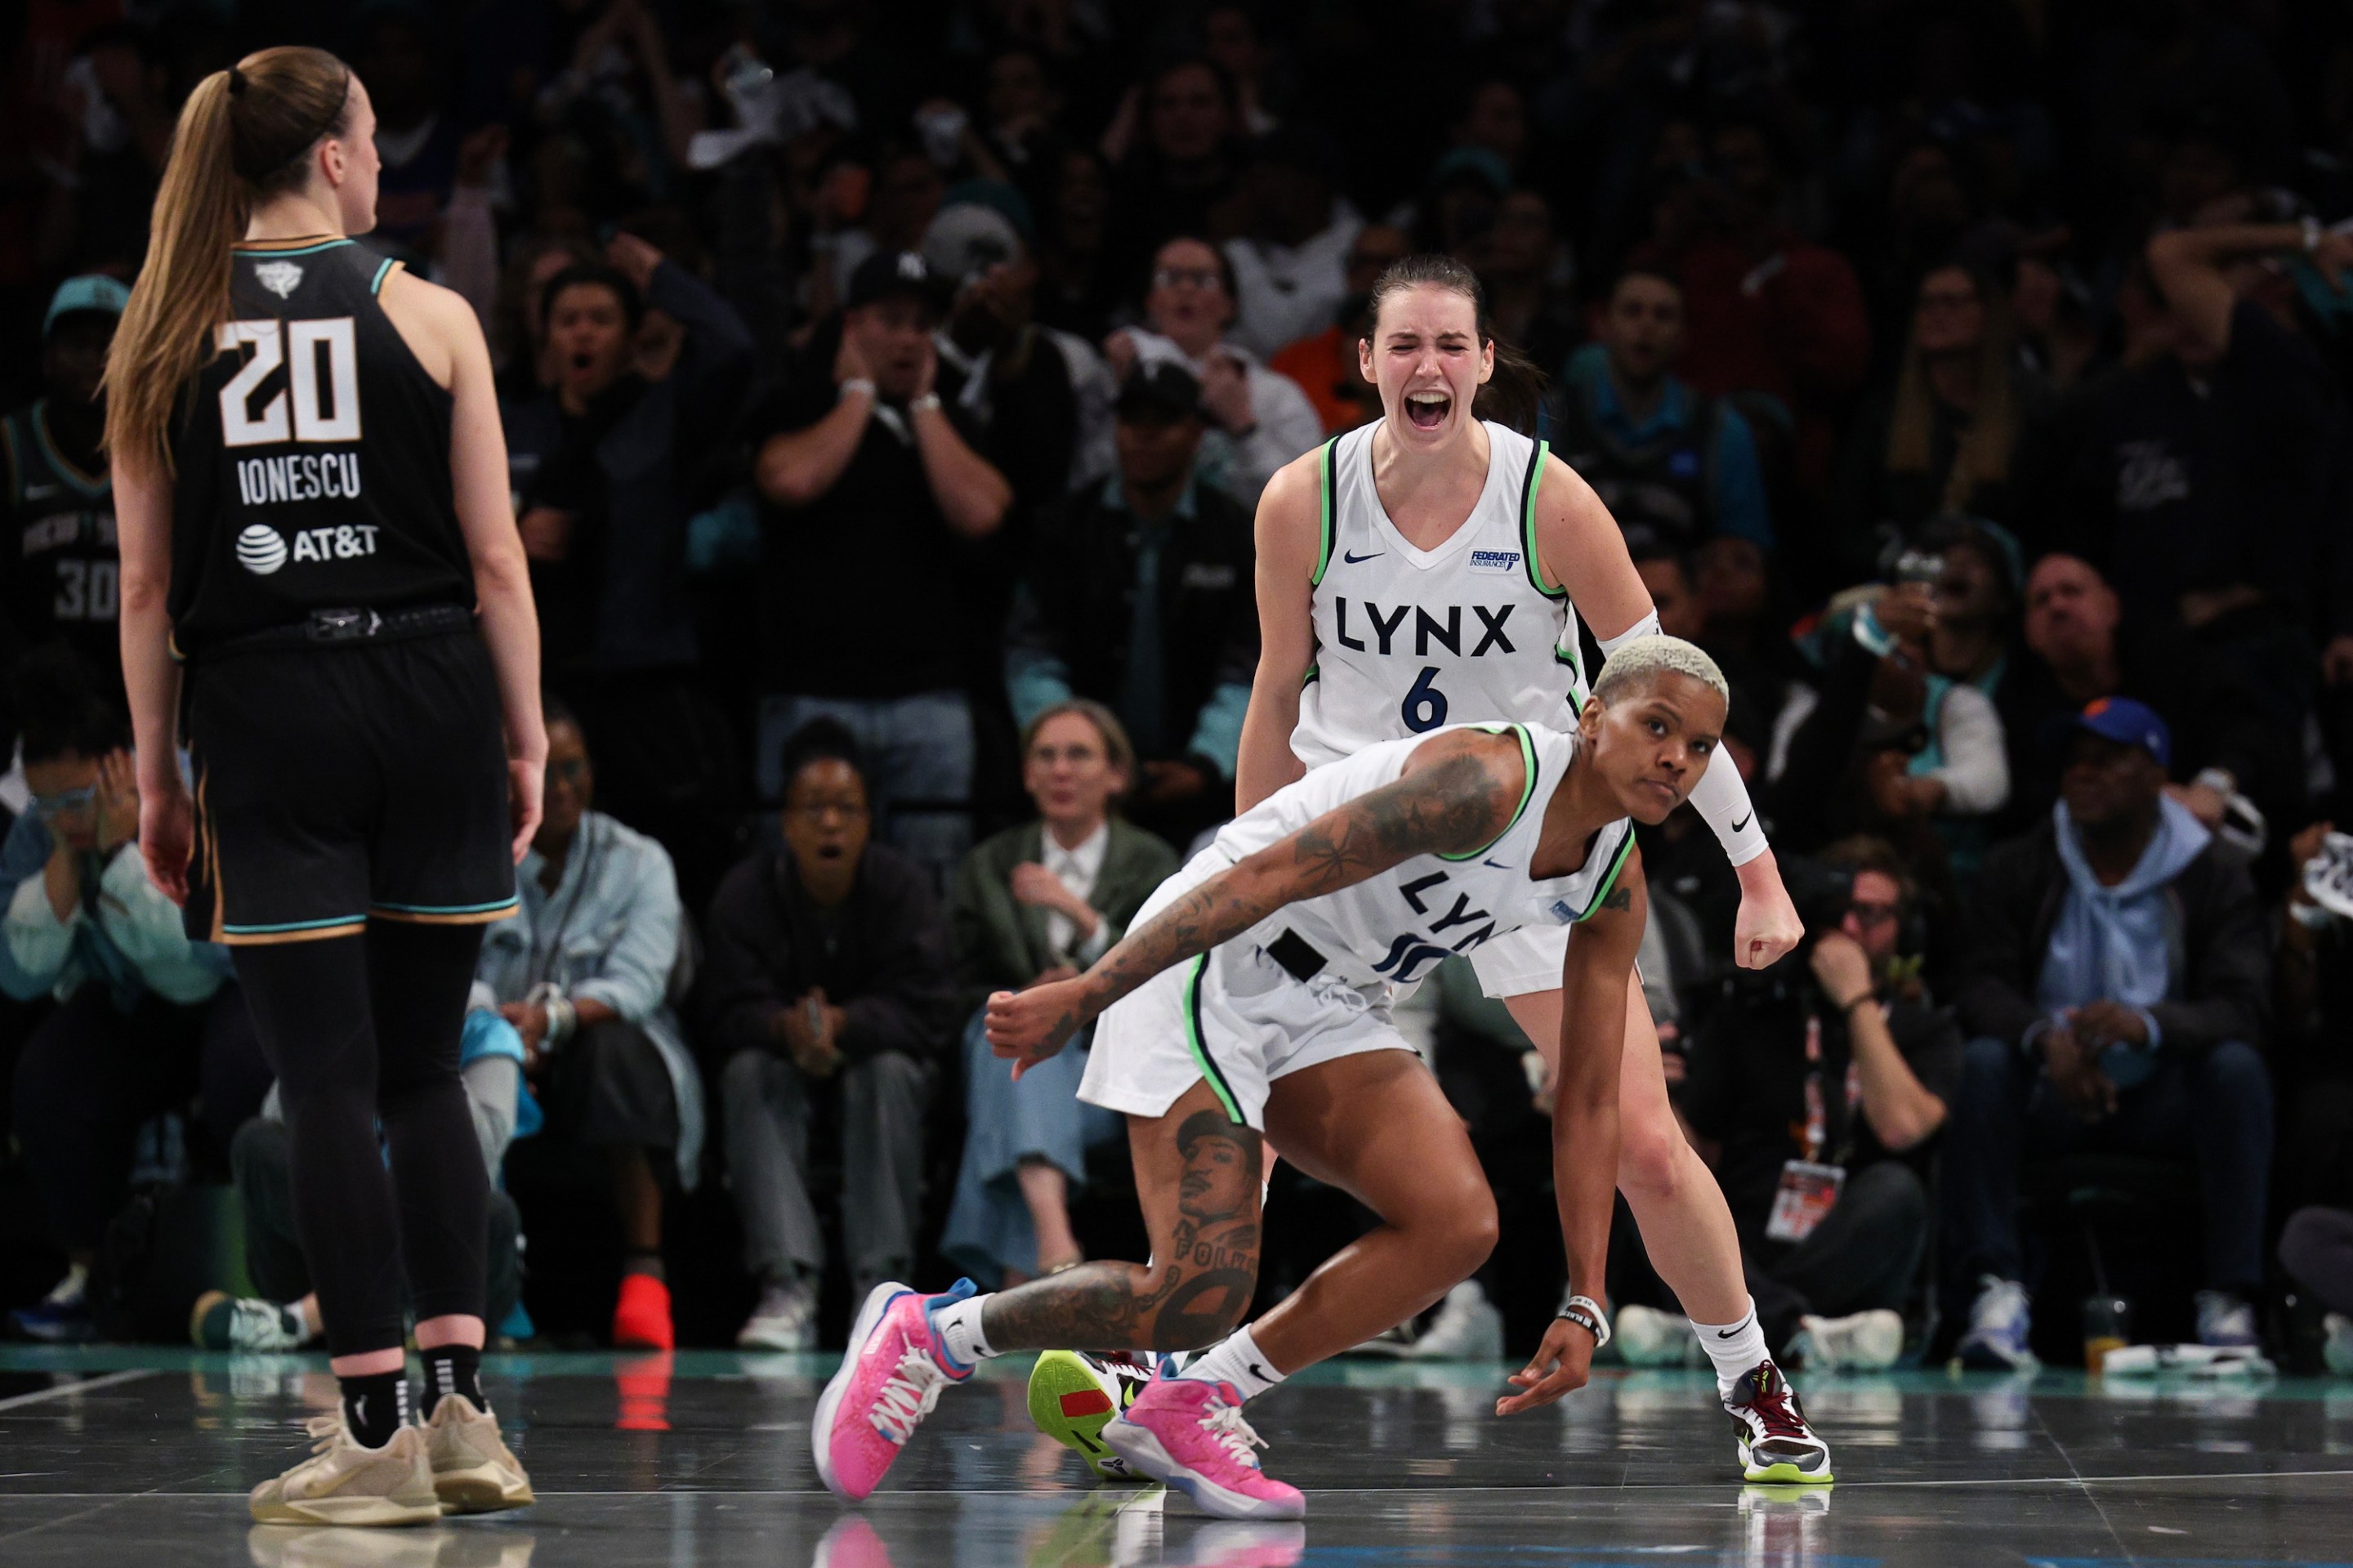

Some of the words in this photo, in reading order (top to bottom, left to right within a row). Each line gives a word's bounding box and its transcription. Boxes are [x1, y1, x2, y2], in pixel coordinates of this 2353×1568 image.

[213, 316, 362, 448] 20
[237, 452, 361, 505] IONESCU
[293, 525, 380, 562] AT&T
[1471, 551, 1520, 561] FEDERATED
[53, 557, 120, 622] 30
[1336, 596, 1516, 657] LYNX
[1401, 666, 1448, 733] 6
